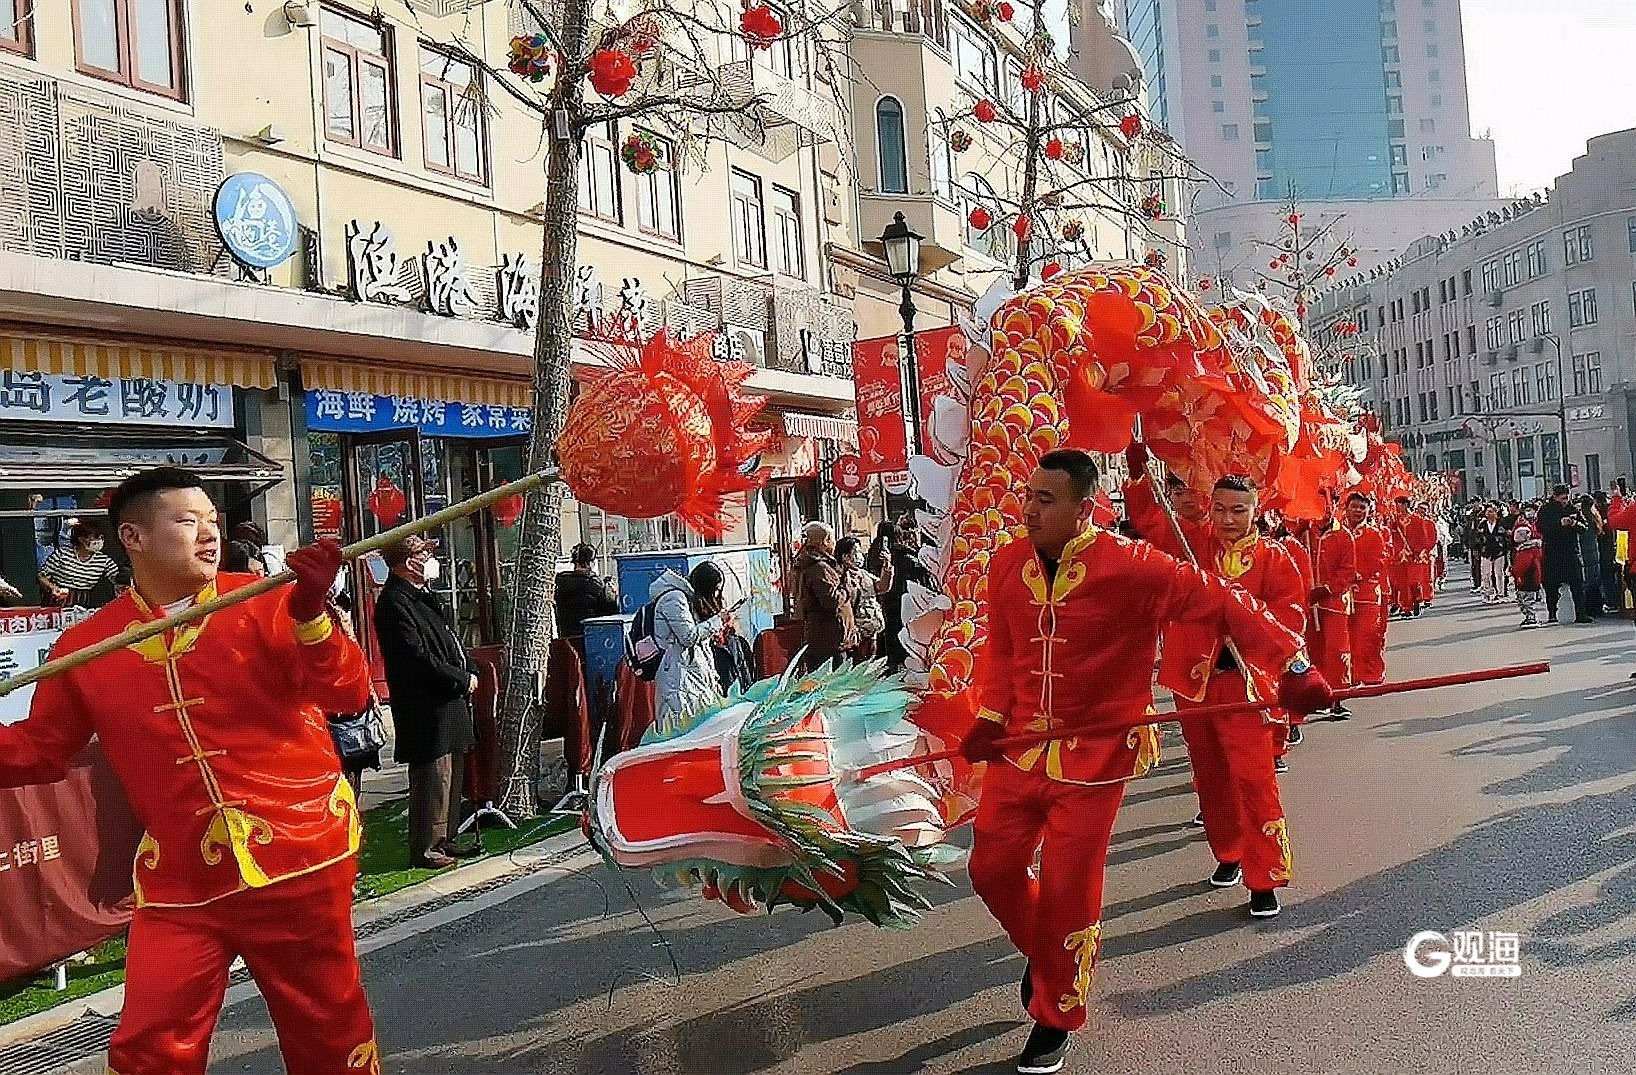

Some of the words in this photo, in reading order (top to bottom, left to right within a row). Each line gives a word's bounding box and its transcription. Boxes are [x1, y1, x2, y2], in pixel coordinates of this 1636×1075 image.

[315, 390, 376, 422] 海鲜
[393, 396, 446, 426] 烧烤
[461, 402, 531, 431] 家常菜
